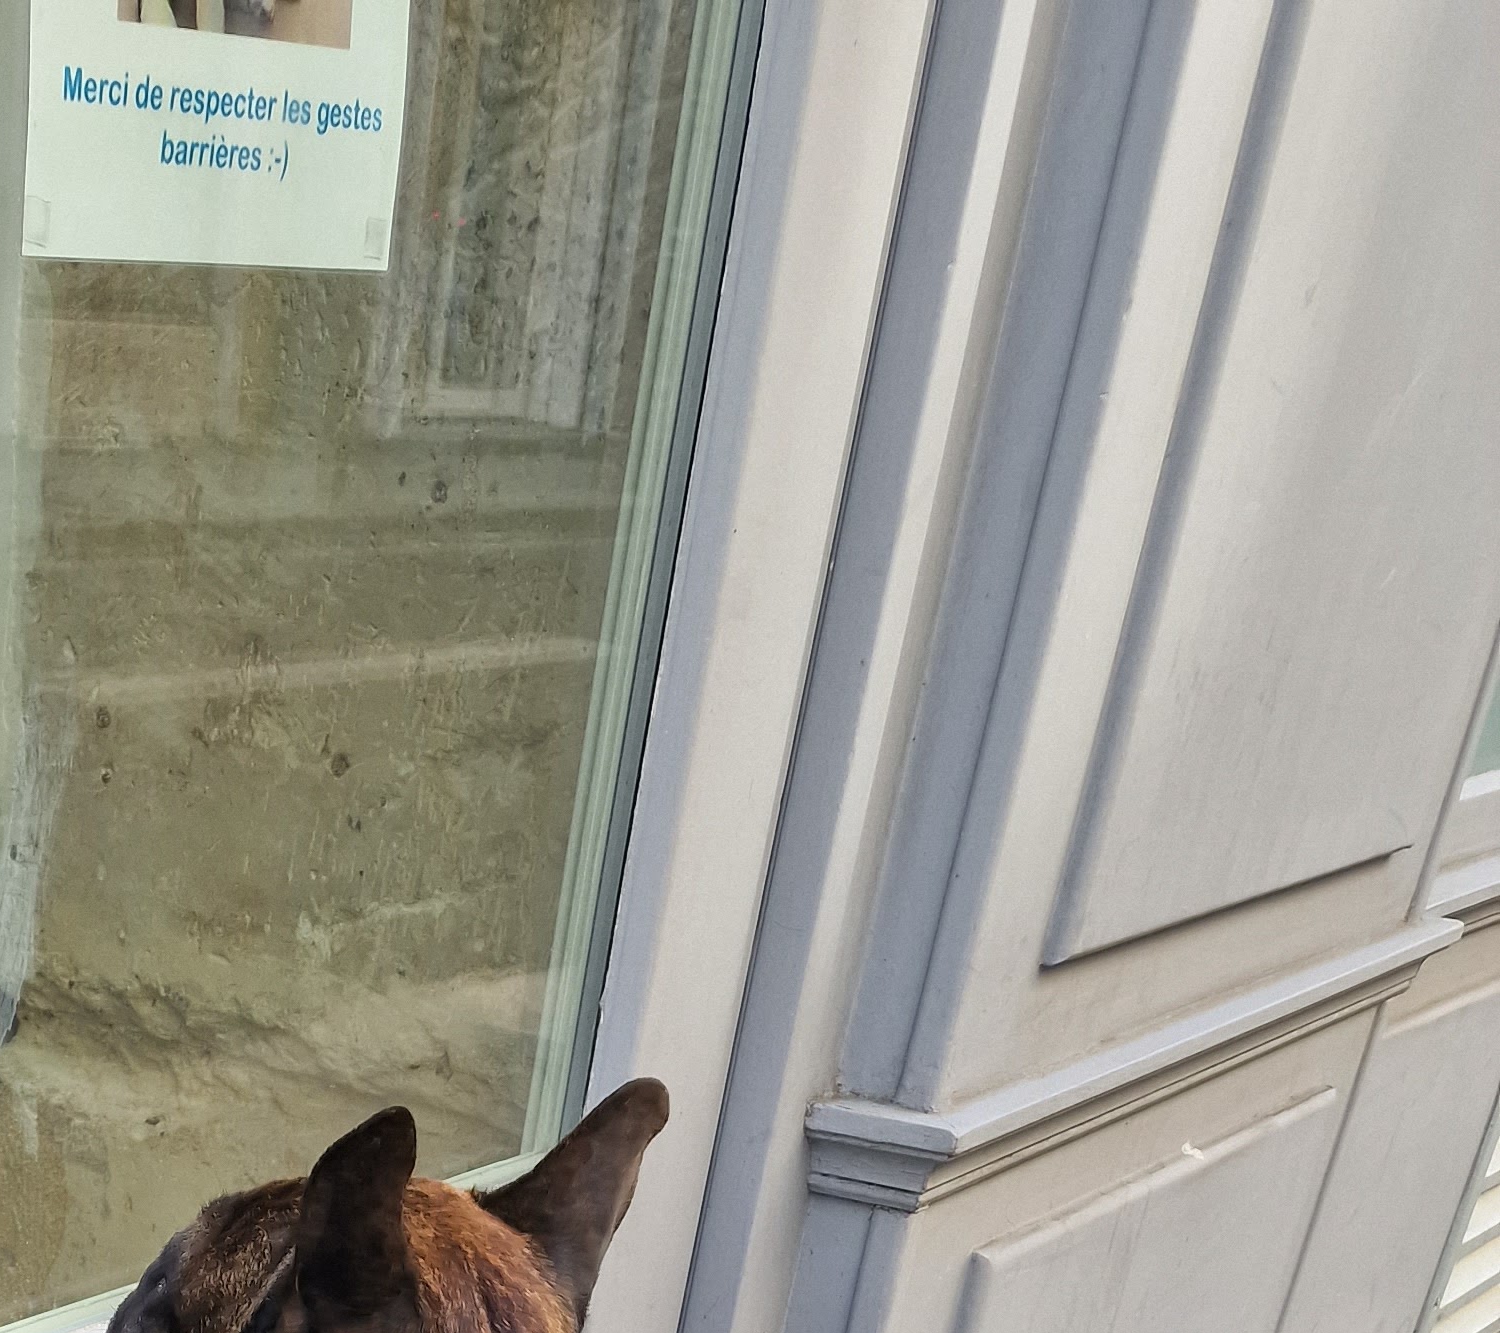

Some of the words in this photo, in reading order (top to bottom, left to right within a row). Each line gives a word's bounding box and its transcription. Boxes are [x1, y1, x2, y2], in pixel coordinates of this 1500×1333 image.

[63, 66, 129, 107] Merci
[135, 75, 163, 110] de
[169, 86, 278, 124] respecter
[282, 90, 311, 125] les
[316, 99, 383, 135] gestes
[160, 130, 262, 172] barrières
[267, 141, 289, 181] :-)
